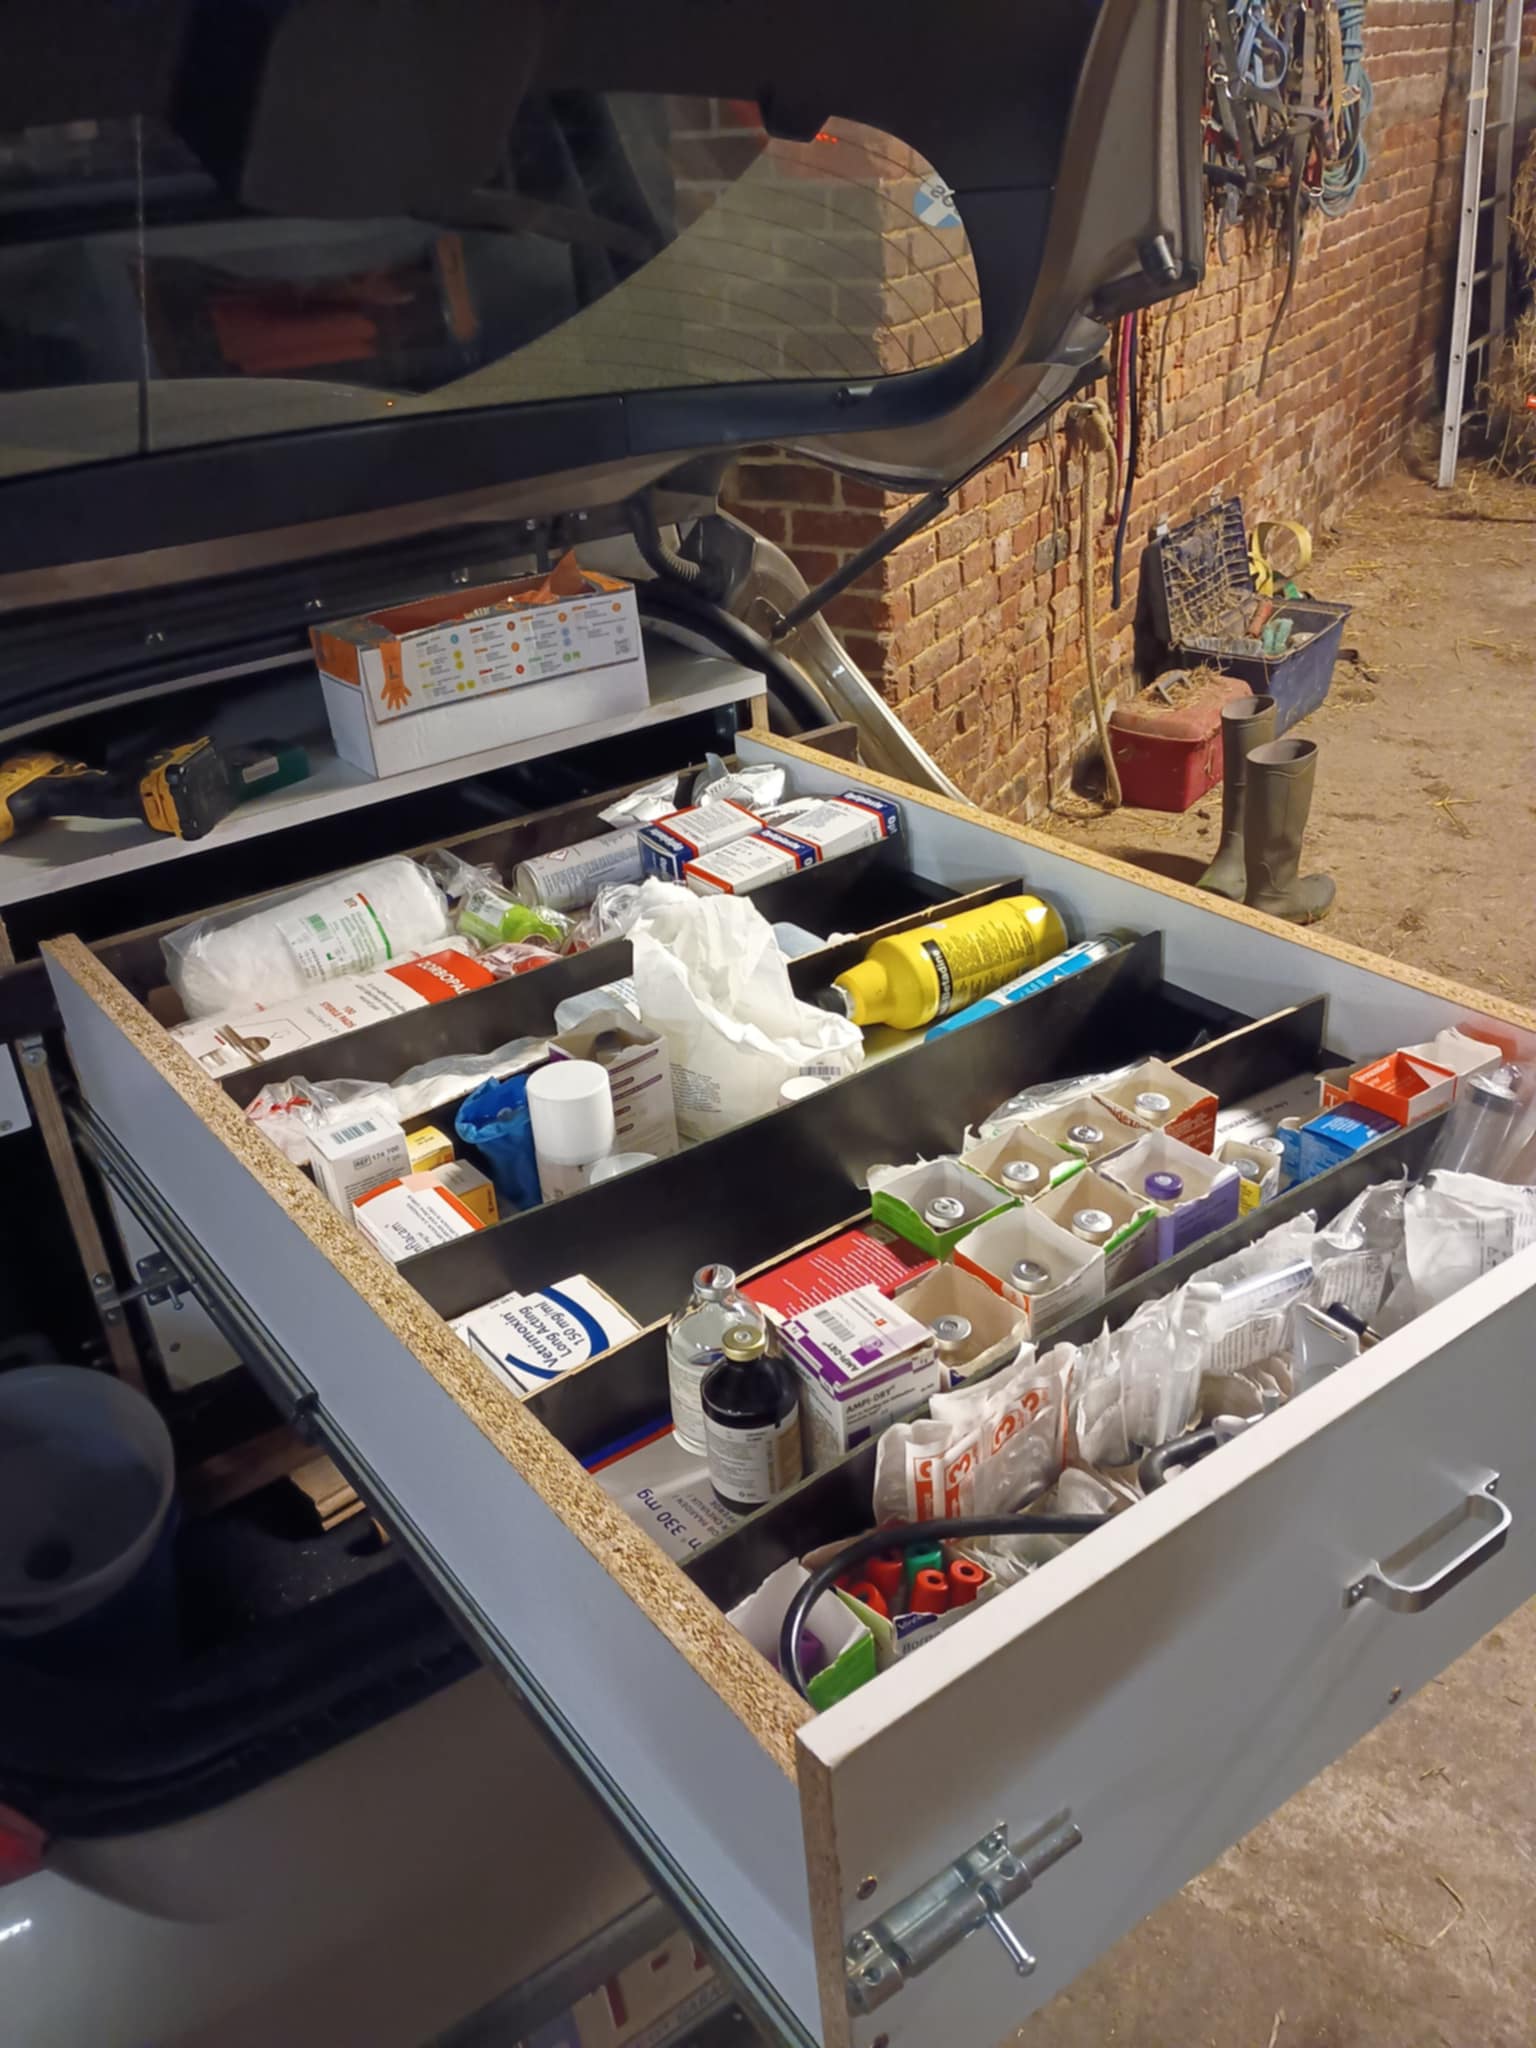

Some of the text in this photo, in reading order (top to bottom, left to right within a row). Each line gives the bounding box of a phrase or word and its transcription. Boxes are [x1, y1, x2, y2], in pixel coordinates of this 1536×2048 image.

[416, 959, 471, 995] ZORBOPA
[391, 1221, 424, 1254] nflacam
[503, 1312, 558, 1368] Vetrimoxin
[519, 1305, 573, 1358] Long Acting
[535, 1301, 585, 1346] 150 mg/ml
[636, 1487, 662, 1512] mg
[656, 1510, 687, 1537] 330
